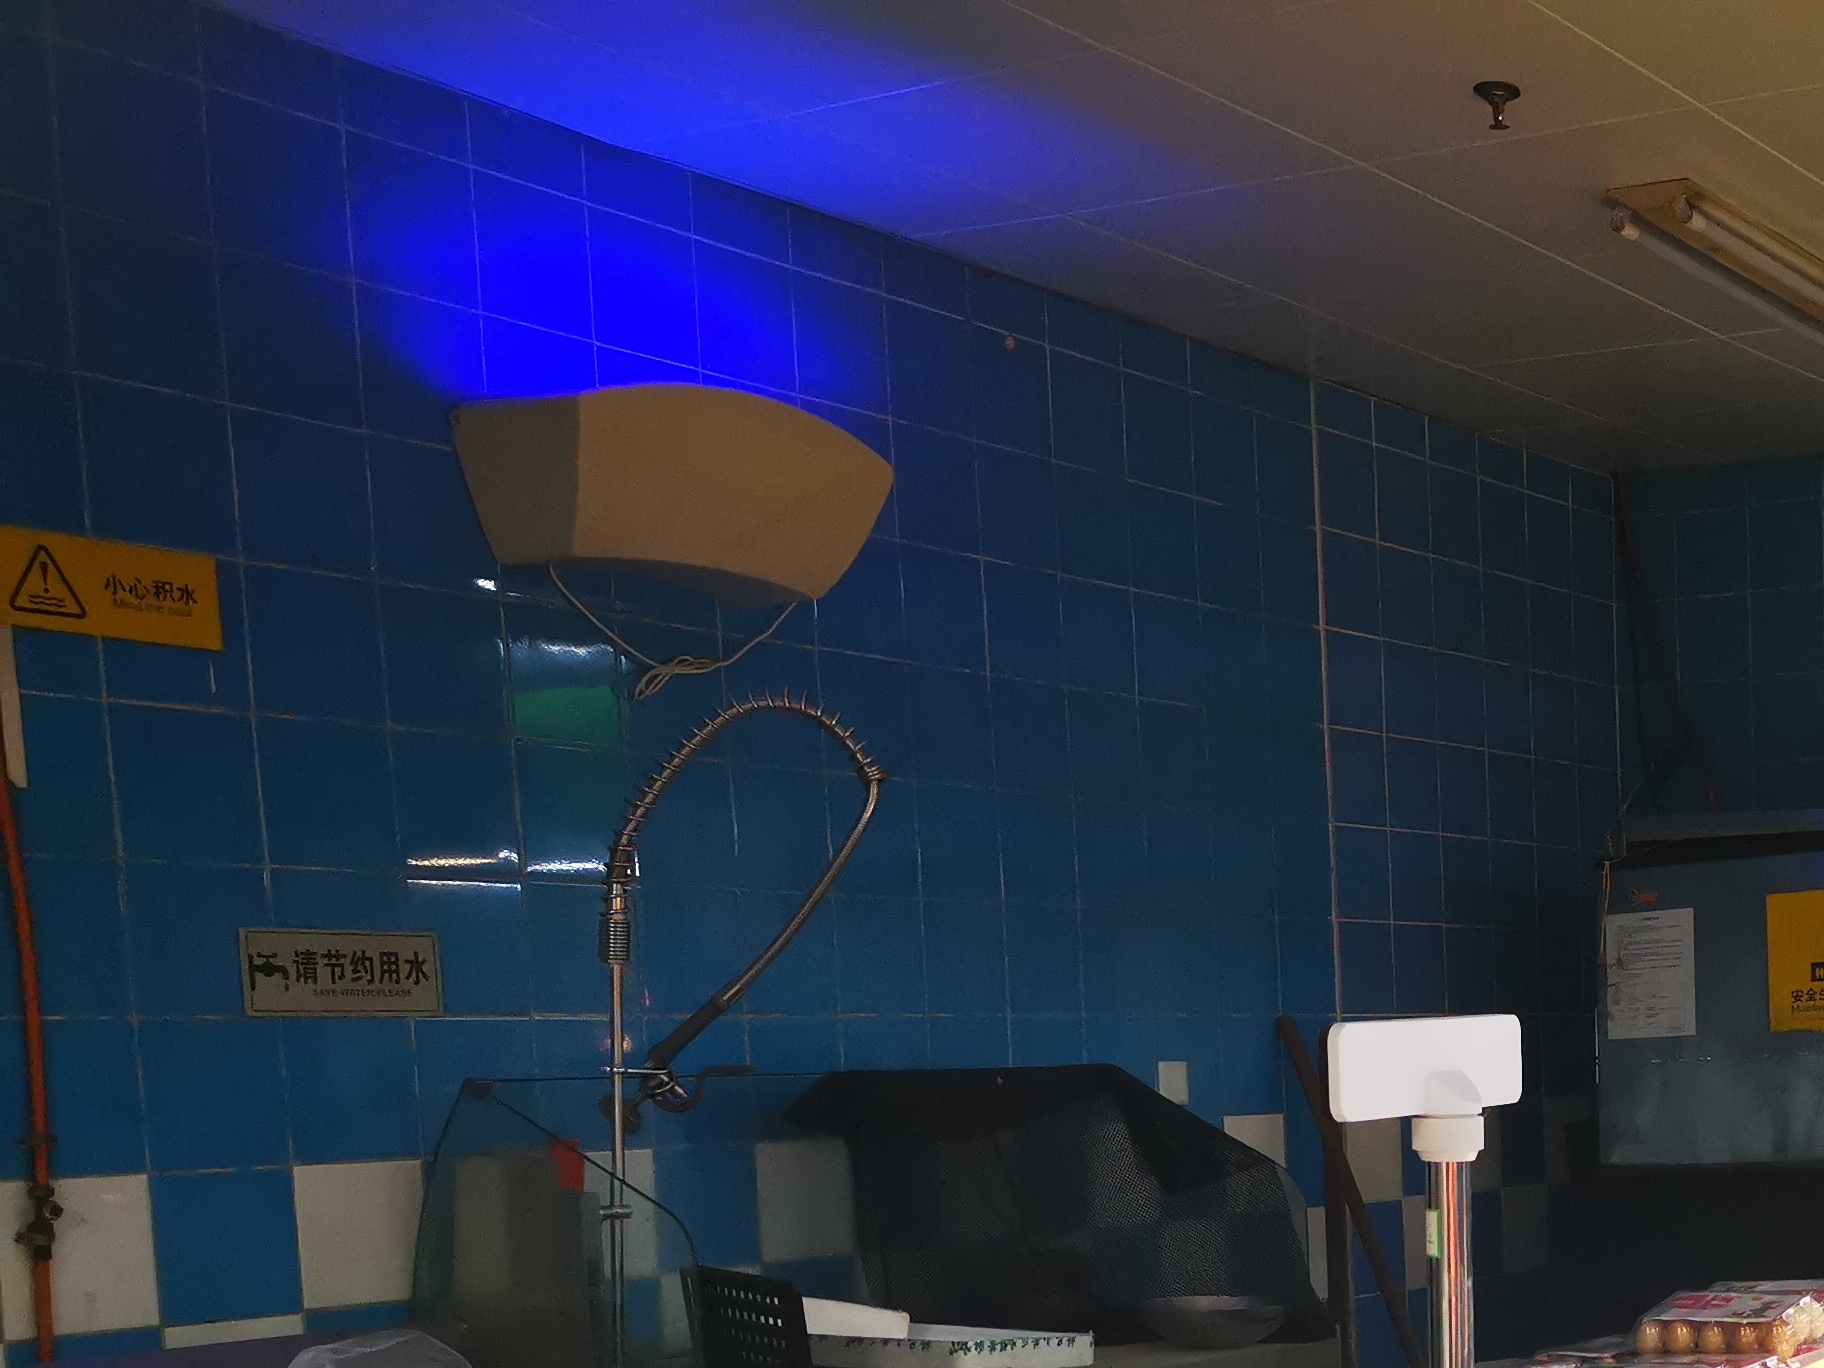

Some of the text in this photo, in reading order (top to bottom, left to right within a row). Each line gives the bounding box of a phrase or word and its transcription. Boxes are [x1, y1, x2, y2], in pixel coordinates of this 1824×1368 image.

[103, 574, 198, 605] 小心积水
[291, 949, 430, 986] 请节约用水
